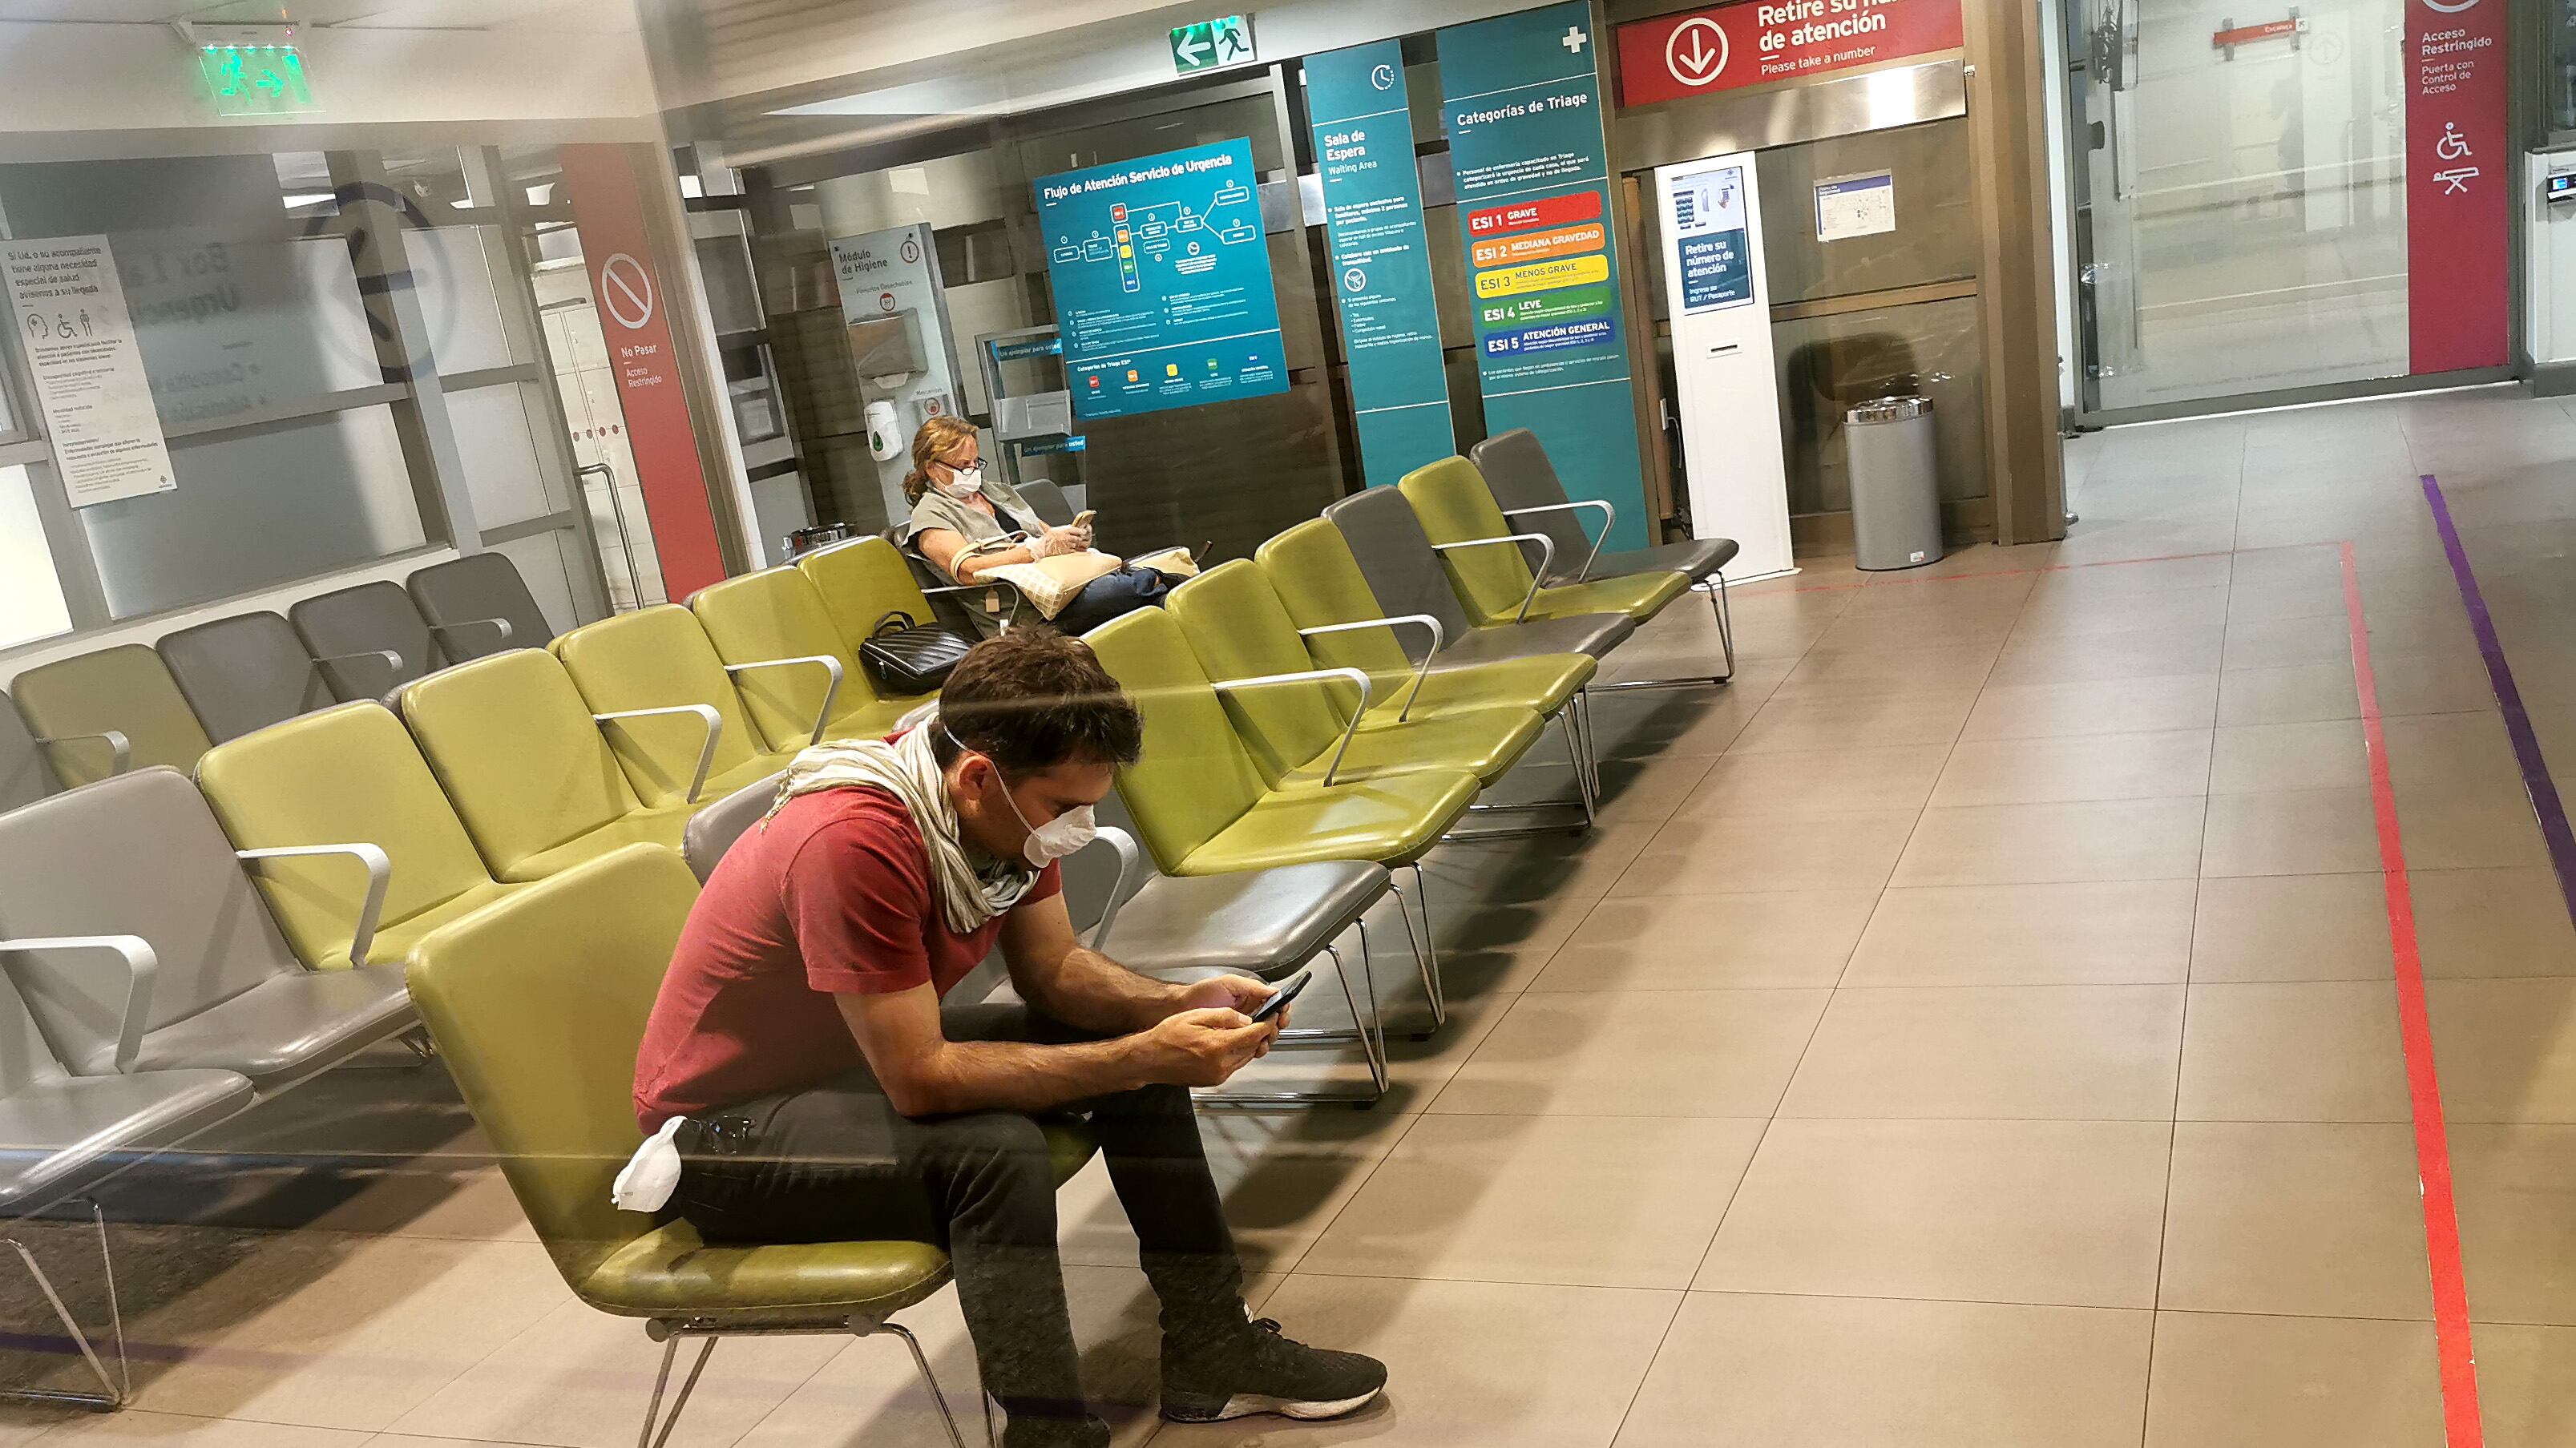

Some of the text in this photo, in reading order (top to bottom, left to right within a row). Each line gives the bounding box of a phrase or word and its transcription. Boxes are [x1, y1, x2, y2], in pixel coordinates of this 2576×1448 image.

[1758, 0, 1824, 26] Retire
[1759, 10, 1885, 51] de atención
[2422, 29, 2465, 42] Acceso
[2422, 37, 2492, 55] Restringido
[1762, 46, 1875, 75] Please take a number
[2422, 61, 2474, 75] Puerta con
[2422, 71, 2471, 84] Control de
[2423, 84, 2456, 95] Acceso
[1457, 94, 1588, 125] Categorías de Triage
[1324, 130, 1365, 147] Sala de
[1326, 146, 1366, 162] Espera
[1328, 160, 1377, 175] Waiting Area
[1044, 155, 1232, 200] Flujo de Atención Servicio de Urgencia
[1472, 216, 1493, 230] ESI
[1496, 214, 1502, 226] 1
[1507, 208, 1537, 220] GRAVE
[1476, 248, 1496, 261] ESI
[1500, 246, 1507, 257] 2
[1511, 238, 1551, 252] MEDIANA
[1552, 230, 1599, 244] GRAVEDAD
[1686, 241, 1726, 255] Retire su
[839, 250, 870, 263] Módulo
[1686, 251, 1734, 266] número de
[33, 262, 59, 272] alguna
[61, 259, 97, 269] necesidad
[842, 259, 887, 274] de Higiene
[1688, 263, 1726, 277] atención
[15, 273, 79, 288] especial de salud
[1481, 278, 1500, 290] ESI
[1504, 276, 1510, 287] 3
[1515, 268, 1545, 279] MENOS
[1548, 264, 1577, 274] GRAVE
[1484, 309, 1504, 321] ESI
[1507, 307, 1515, 318] 4
[1519, 300, 1542, 310] LEVE
[1488, 339, 1508, 353] ESI
[1512, 337, 1519, 349] 5
[1524, 327, 1566, 341] ATENCIÓN
[1569, 321, 1610, 335] GENERAL
[621, 345, 657, 358] No Pasar
[626, 368, 648, 377] Acceso
[628, 375, 663, 388] Restringido
